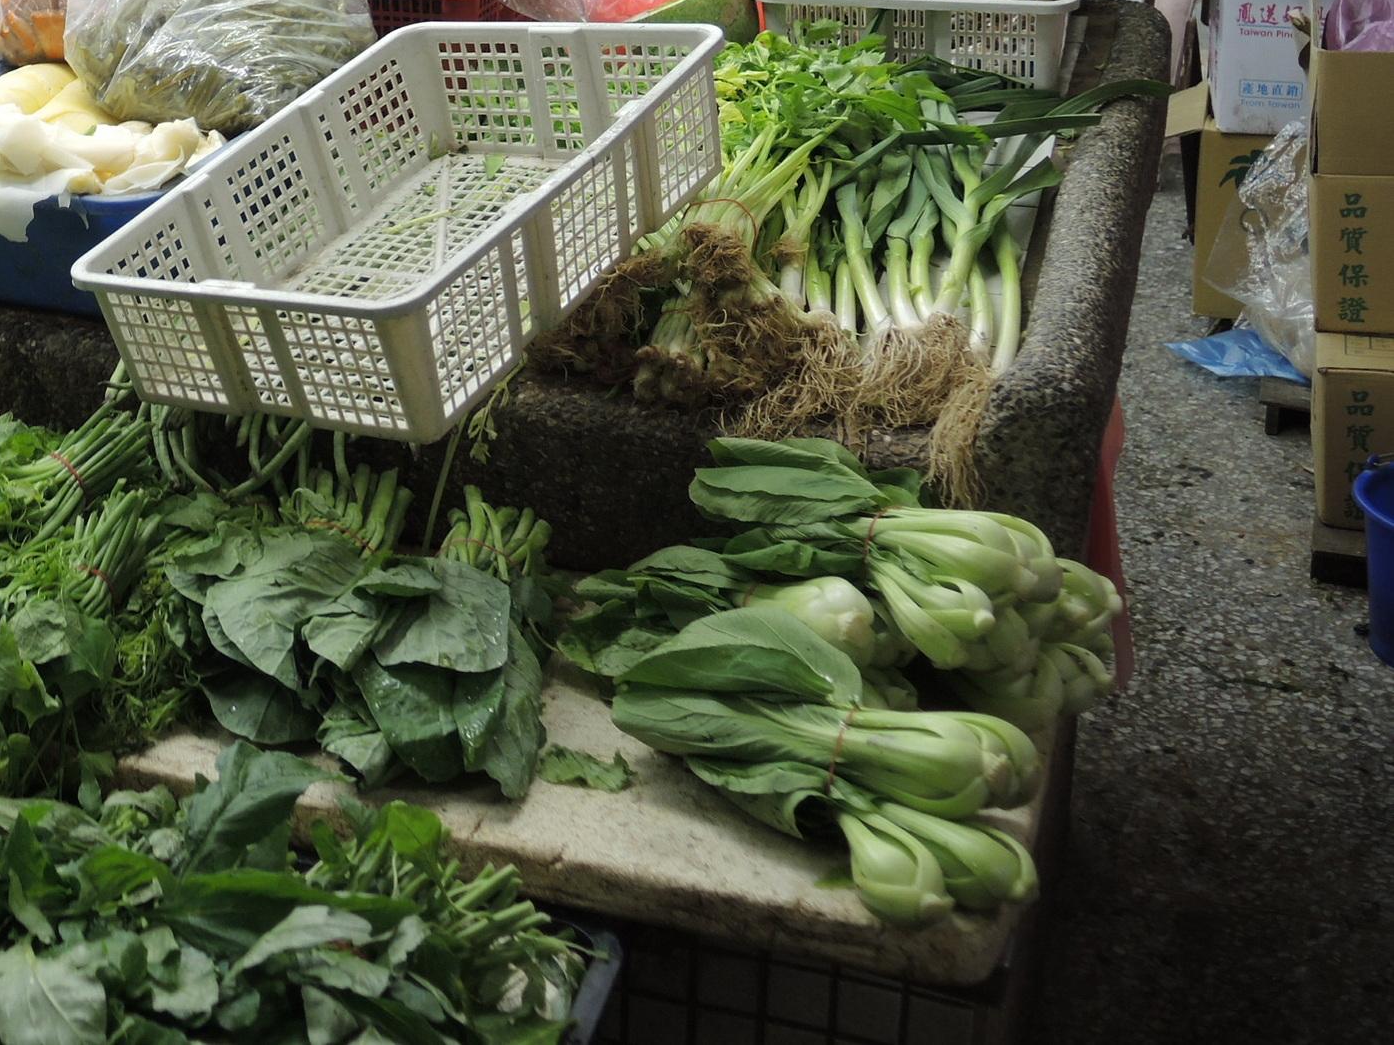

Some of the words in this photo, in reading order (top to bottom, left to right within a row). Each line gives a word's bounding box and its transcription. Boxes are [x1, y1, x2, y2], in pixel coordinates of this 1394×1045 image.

[1239, 28, 1273, 38] Taiwan
[1241, 82, 1300, 98] 產地直銷
[1240, 99, 1264, 108] From
[1267, 100, 1301, 110] Taiwan
[1338, 192, 1370, 324] 品質保證
